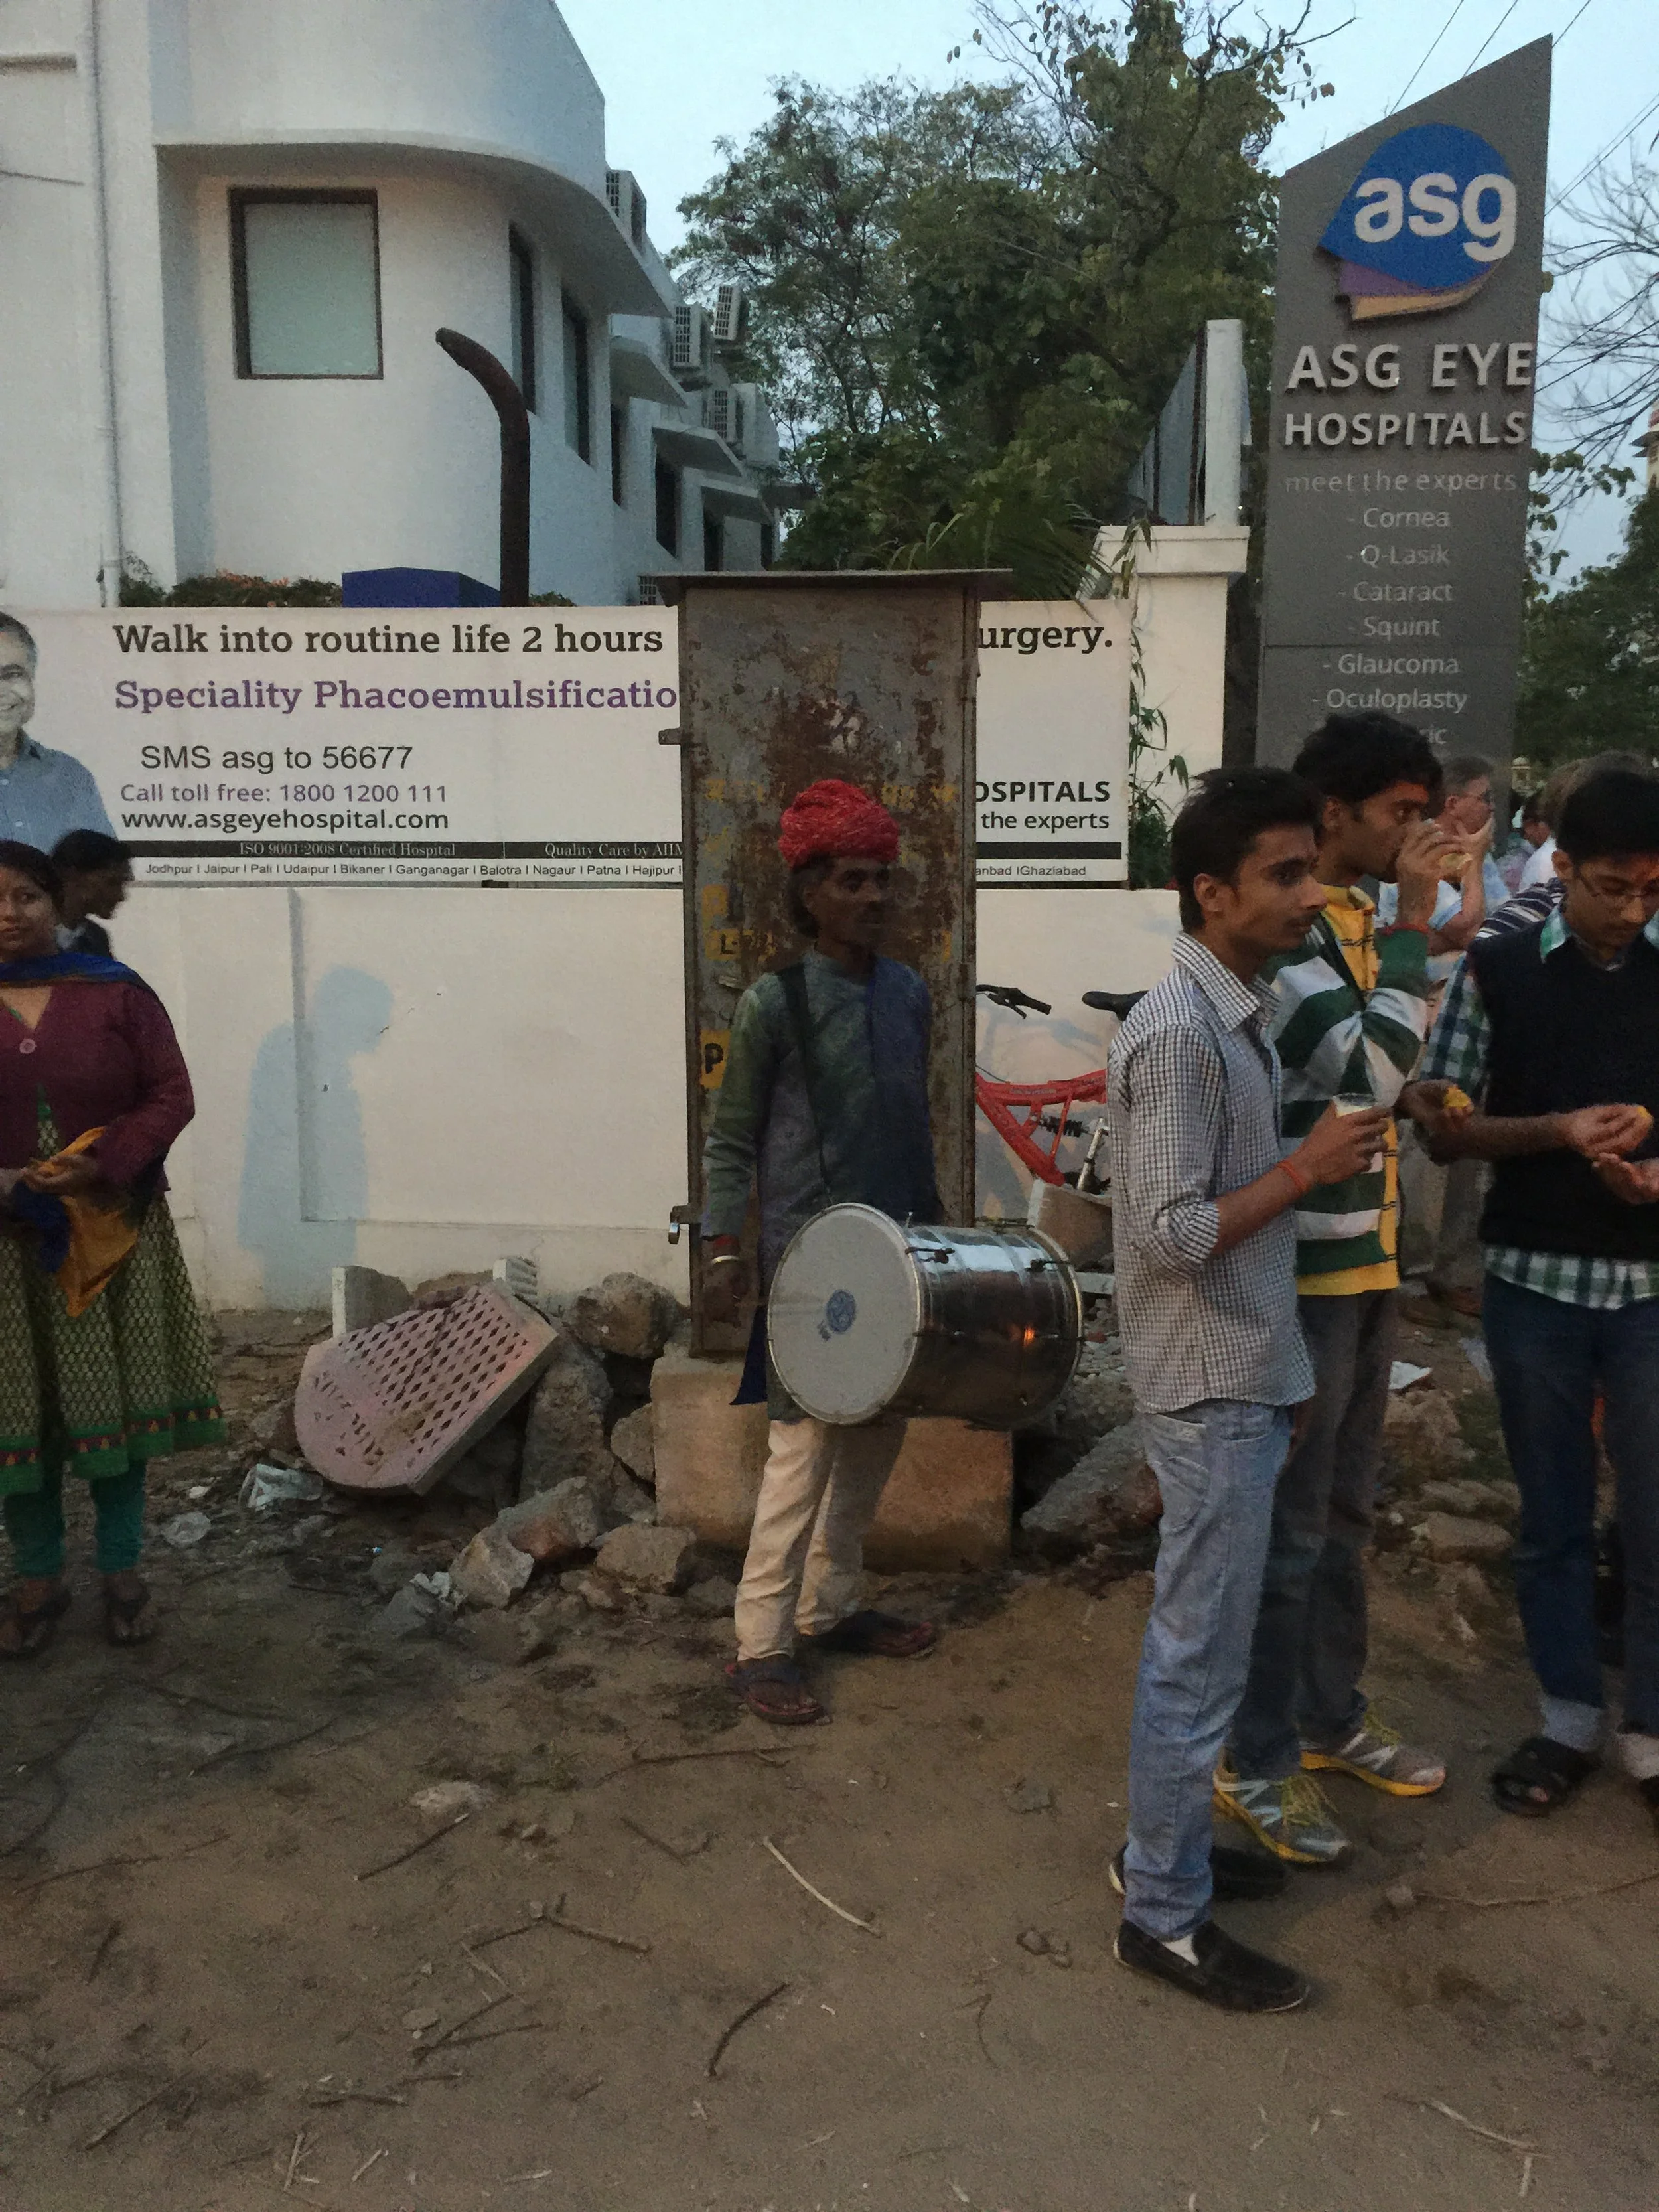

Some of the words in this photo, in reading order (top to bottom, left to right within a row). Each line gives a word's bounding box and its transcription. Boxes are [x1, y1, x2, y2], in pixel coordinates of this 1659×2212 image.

[1354, 173, 1517, 263] asg
[1286, 344, 1400, 389] ASG
[1431, 342, 1533, 388] EYE
[1284, 411, 1528, 446] HOSPITALS
[1285, 472, 1354, 492] meet
[1363, 470, 1409, 492] the
[1416, 473, 1517, 496] experts
[1363, 508, 1451, 528] Cornea
[1360, 544, 1449, 568] Q-Lasik
[1354, 581, 1454, 602] Cataract
[113, 624, 208, 653] Walk
[220, 624, 293, 653] into
[305, 624, 439, 653] routine
[452, 624, 510, 653] life
[522, 627, 542, 652] 2
[555, 624, 663, 652] hours
[1363, 617, 1441, 641] Squint
[1338, 654, 1459, 674] Glaucoma
[115, 680, 302, 714] Speciality
[314, 679, 677, 709] Phacoemulsificatio
[1327, 688, 1468, 713] Oculoplasty
[141, 745, 211, 769] SMS
[222, 750, 274, 775] asg
[284, 747, 312, 769] to
[323, 746, 413, 769] 56677
[120, 784, 163, 802] Call
[171, 783, 210, 802] toll
[218, 783, 271, 802] free:
[279, 784, 335, 802] 1800
[346, 784, 399, 802] 1200
[408, 784, 447, 802] 111
[122, 809, 449, 834] www.asgeyehospital.com
[981, 811, 1017, 828] the
[1024, 812, 1110, 833] experts
[240, 842, 265, 855] ISO
[339, 842, 396, 856] Certified
[400, 843, 456, 859] Hospital
[545, 843, 593, 859] Quality
[599, 843, 630, 857] Care
[634, 843, 650, 859] by
[145, 864, 192, 875] Jodhpur
[204, 865, 239, 875] Jaipur
[251, 865, 272, 874] Pali
[283, 865, 329, 877] Udaipur
[340, 865, 385, 874] Bikaner
[396, 865, 469, 878] Ganganagar
[480, 865, 522, 875] Balotra
[533, 865, 575, 878] Nagaur
[587, 865, 621, 875] Patna
[632, 866, 674, 877] Hajipur
